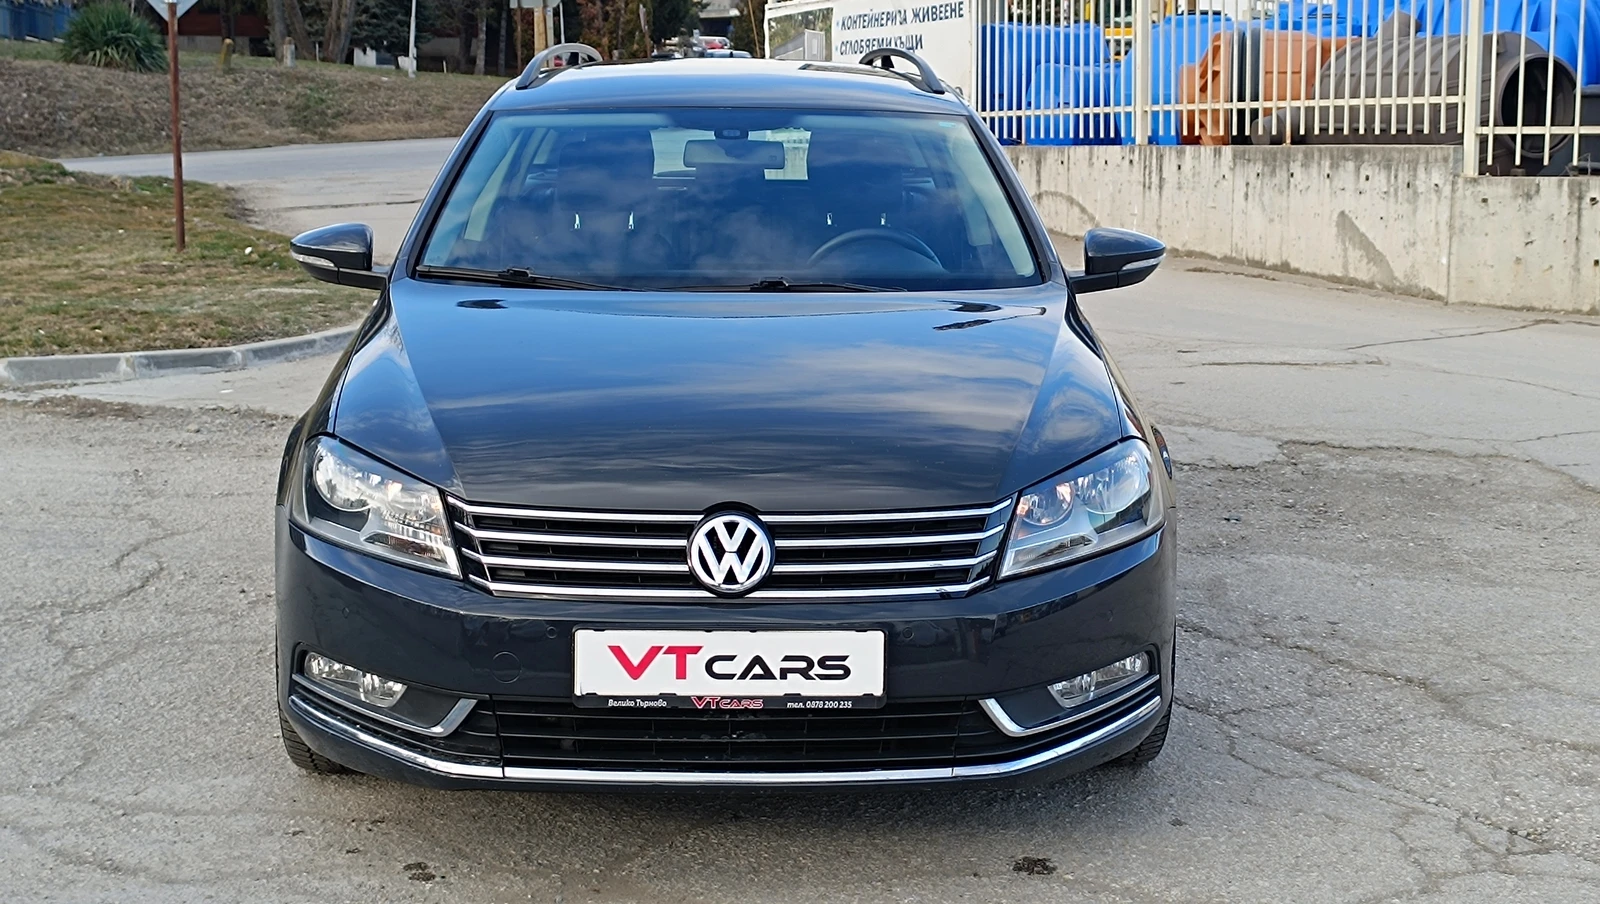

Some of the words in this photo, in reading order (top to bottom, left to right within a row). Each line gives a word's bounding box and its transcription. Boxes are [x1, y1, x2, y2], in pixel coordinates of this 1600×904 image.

[841, 8, 897, 31] КОНТЕЙНЕРИ
[911, 1, 964, 23] ЖИВЕЕНЕ
[840, 37, 892, 55] СГЛОБЯЕМИ
[608, 699, 635, 707] Велико
[636, 699, 667, 708] Търново
[806, 701, 823, 709] 0878
[824, 701, 838, 709] 200
[839, 701, 852, 709] 235
